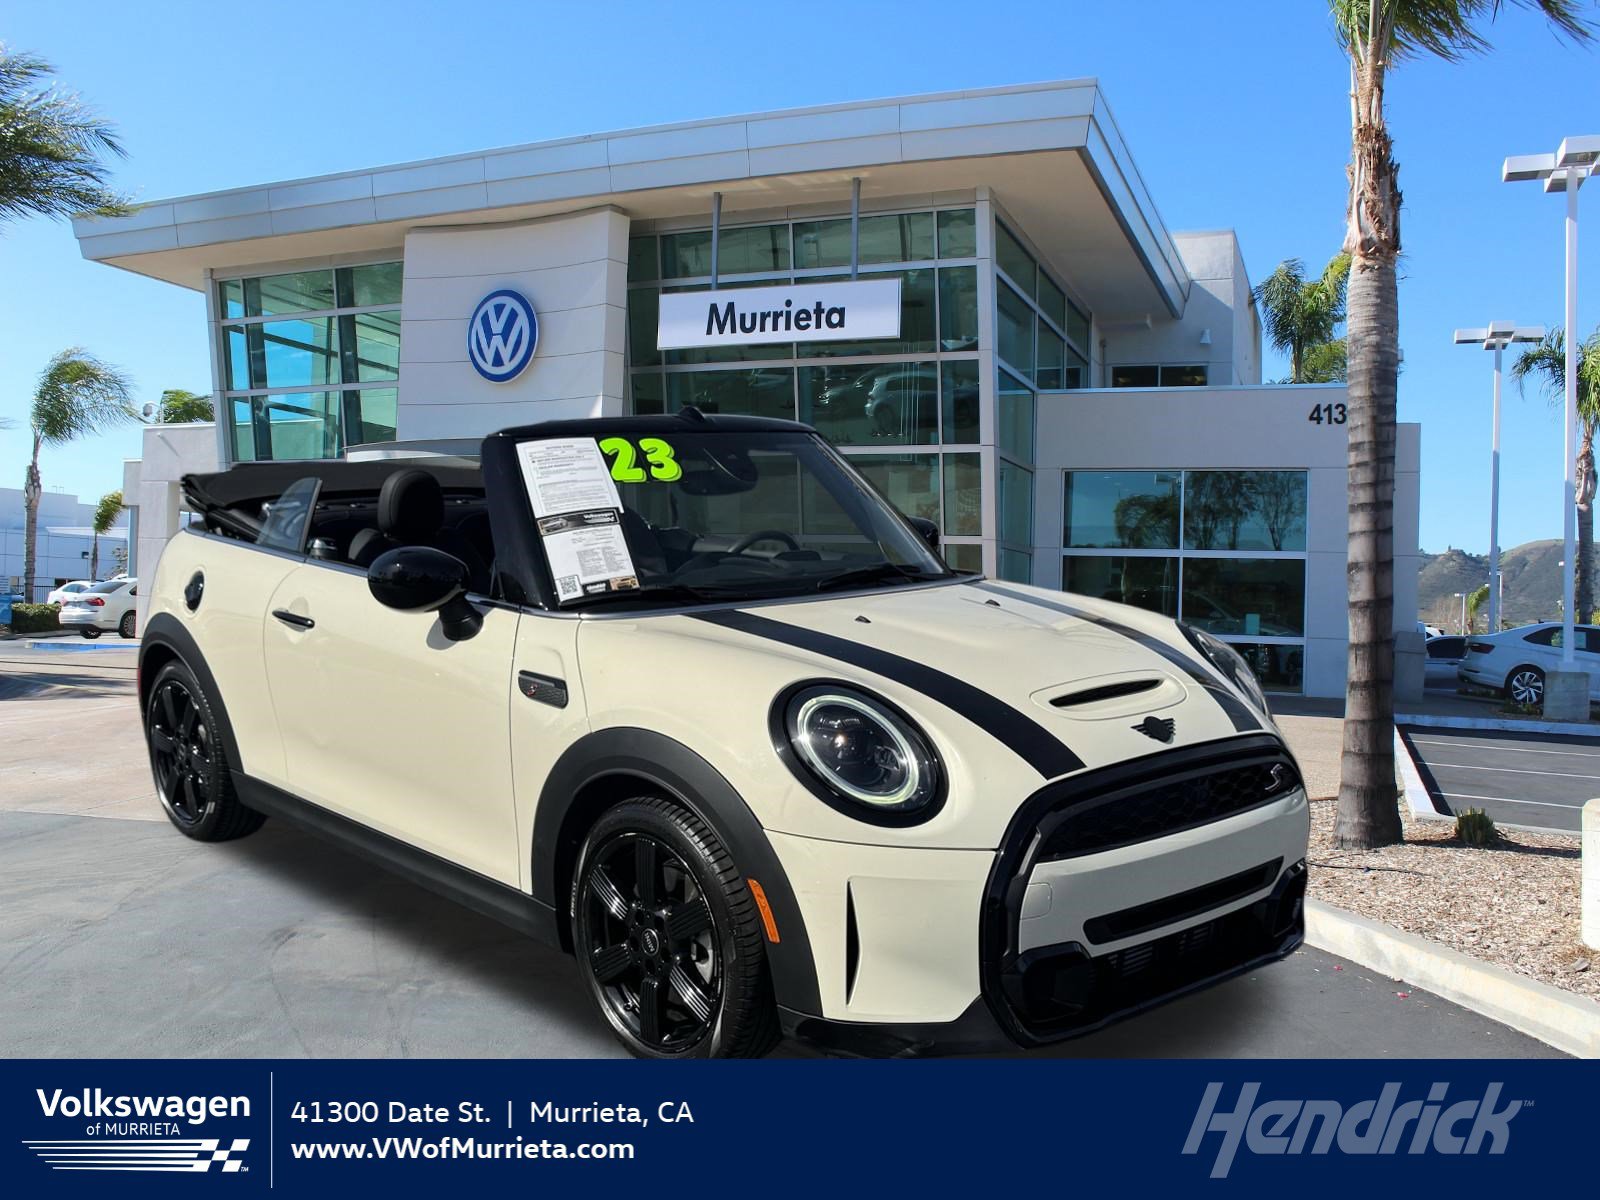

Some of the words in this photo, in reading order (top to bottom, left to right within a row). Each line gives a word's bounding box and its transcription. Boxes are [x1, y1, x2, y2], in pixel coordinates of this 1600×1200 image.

[705, 298, 846, 336] Murrieta
[1308, 403, 1348, 425] 413
[599, 437, 683, 483] 23
